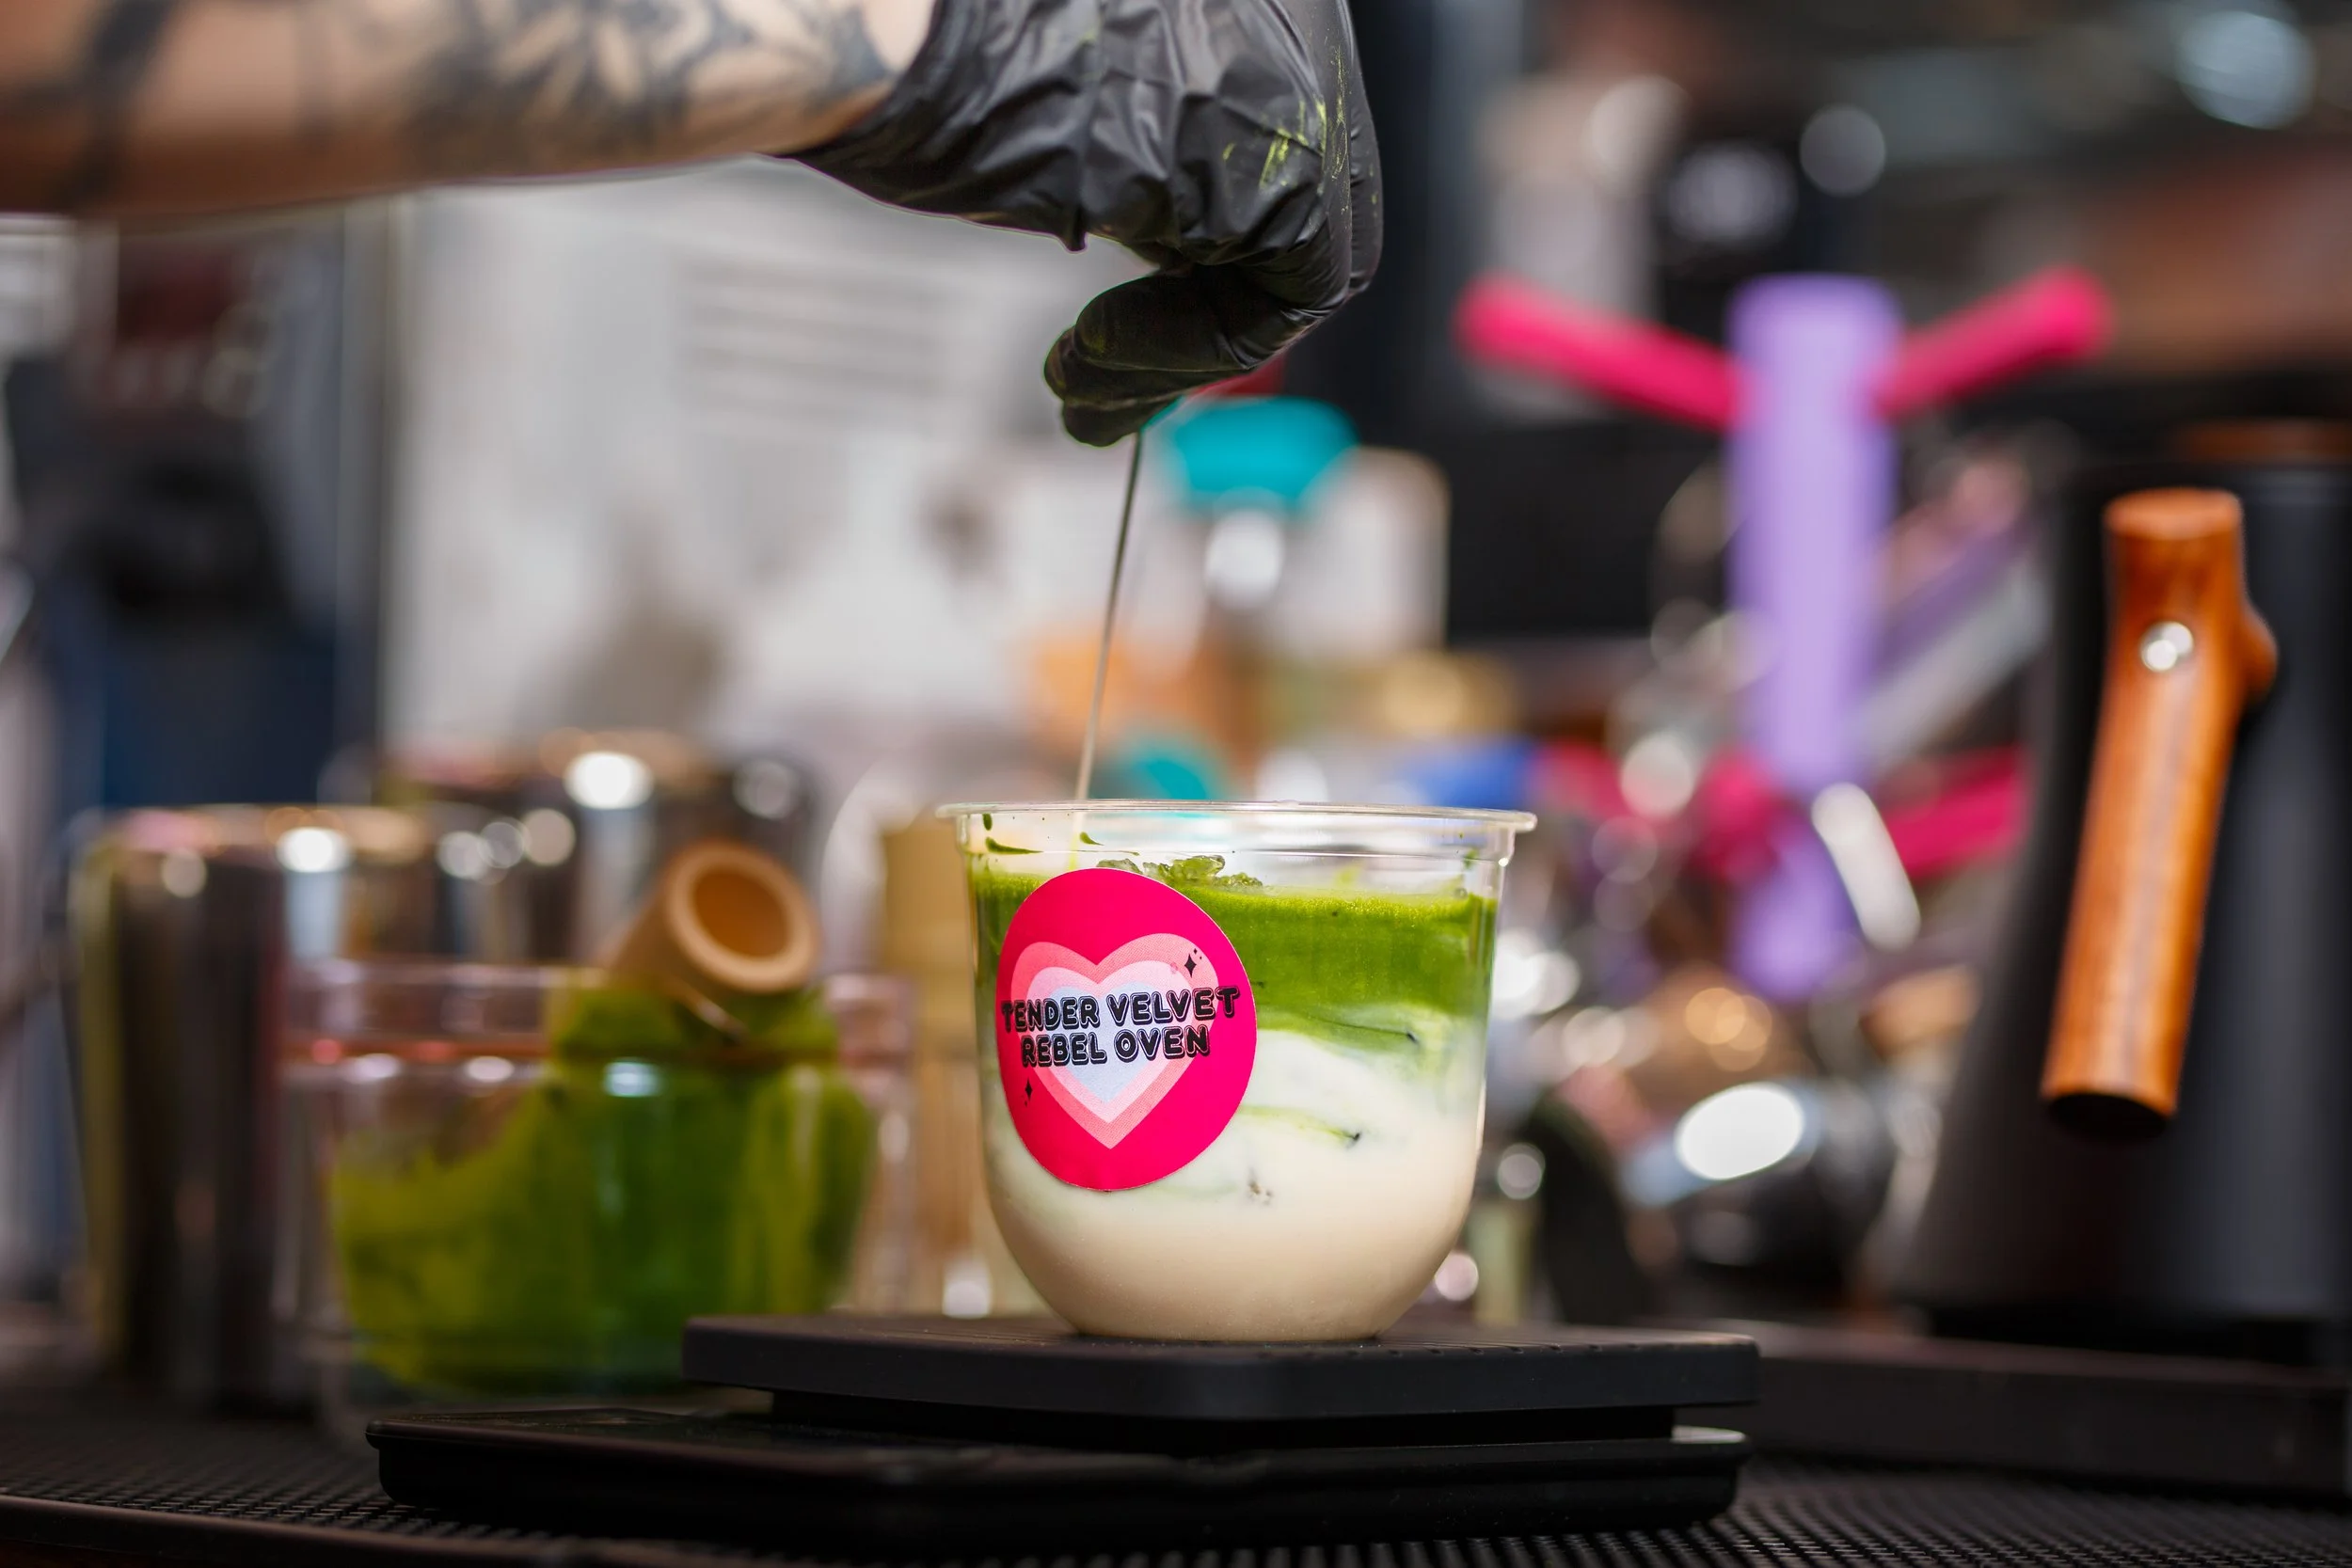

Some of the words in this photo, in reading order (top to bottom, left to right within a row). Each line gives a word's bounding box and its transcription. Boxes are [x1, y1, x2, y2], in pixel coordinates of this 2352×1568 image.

[1001, 996, 1100, 1032] TENDER
[1106, 985, 1240, 1025] VELVET
[1021, 1032, 1107, 1068] REBEL
[1114, 1024, 1211, 1063] OVEN
